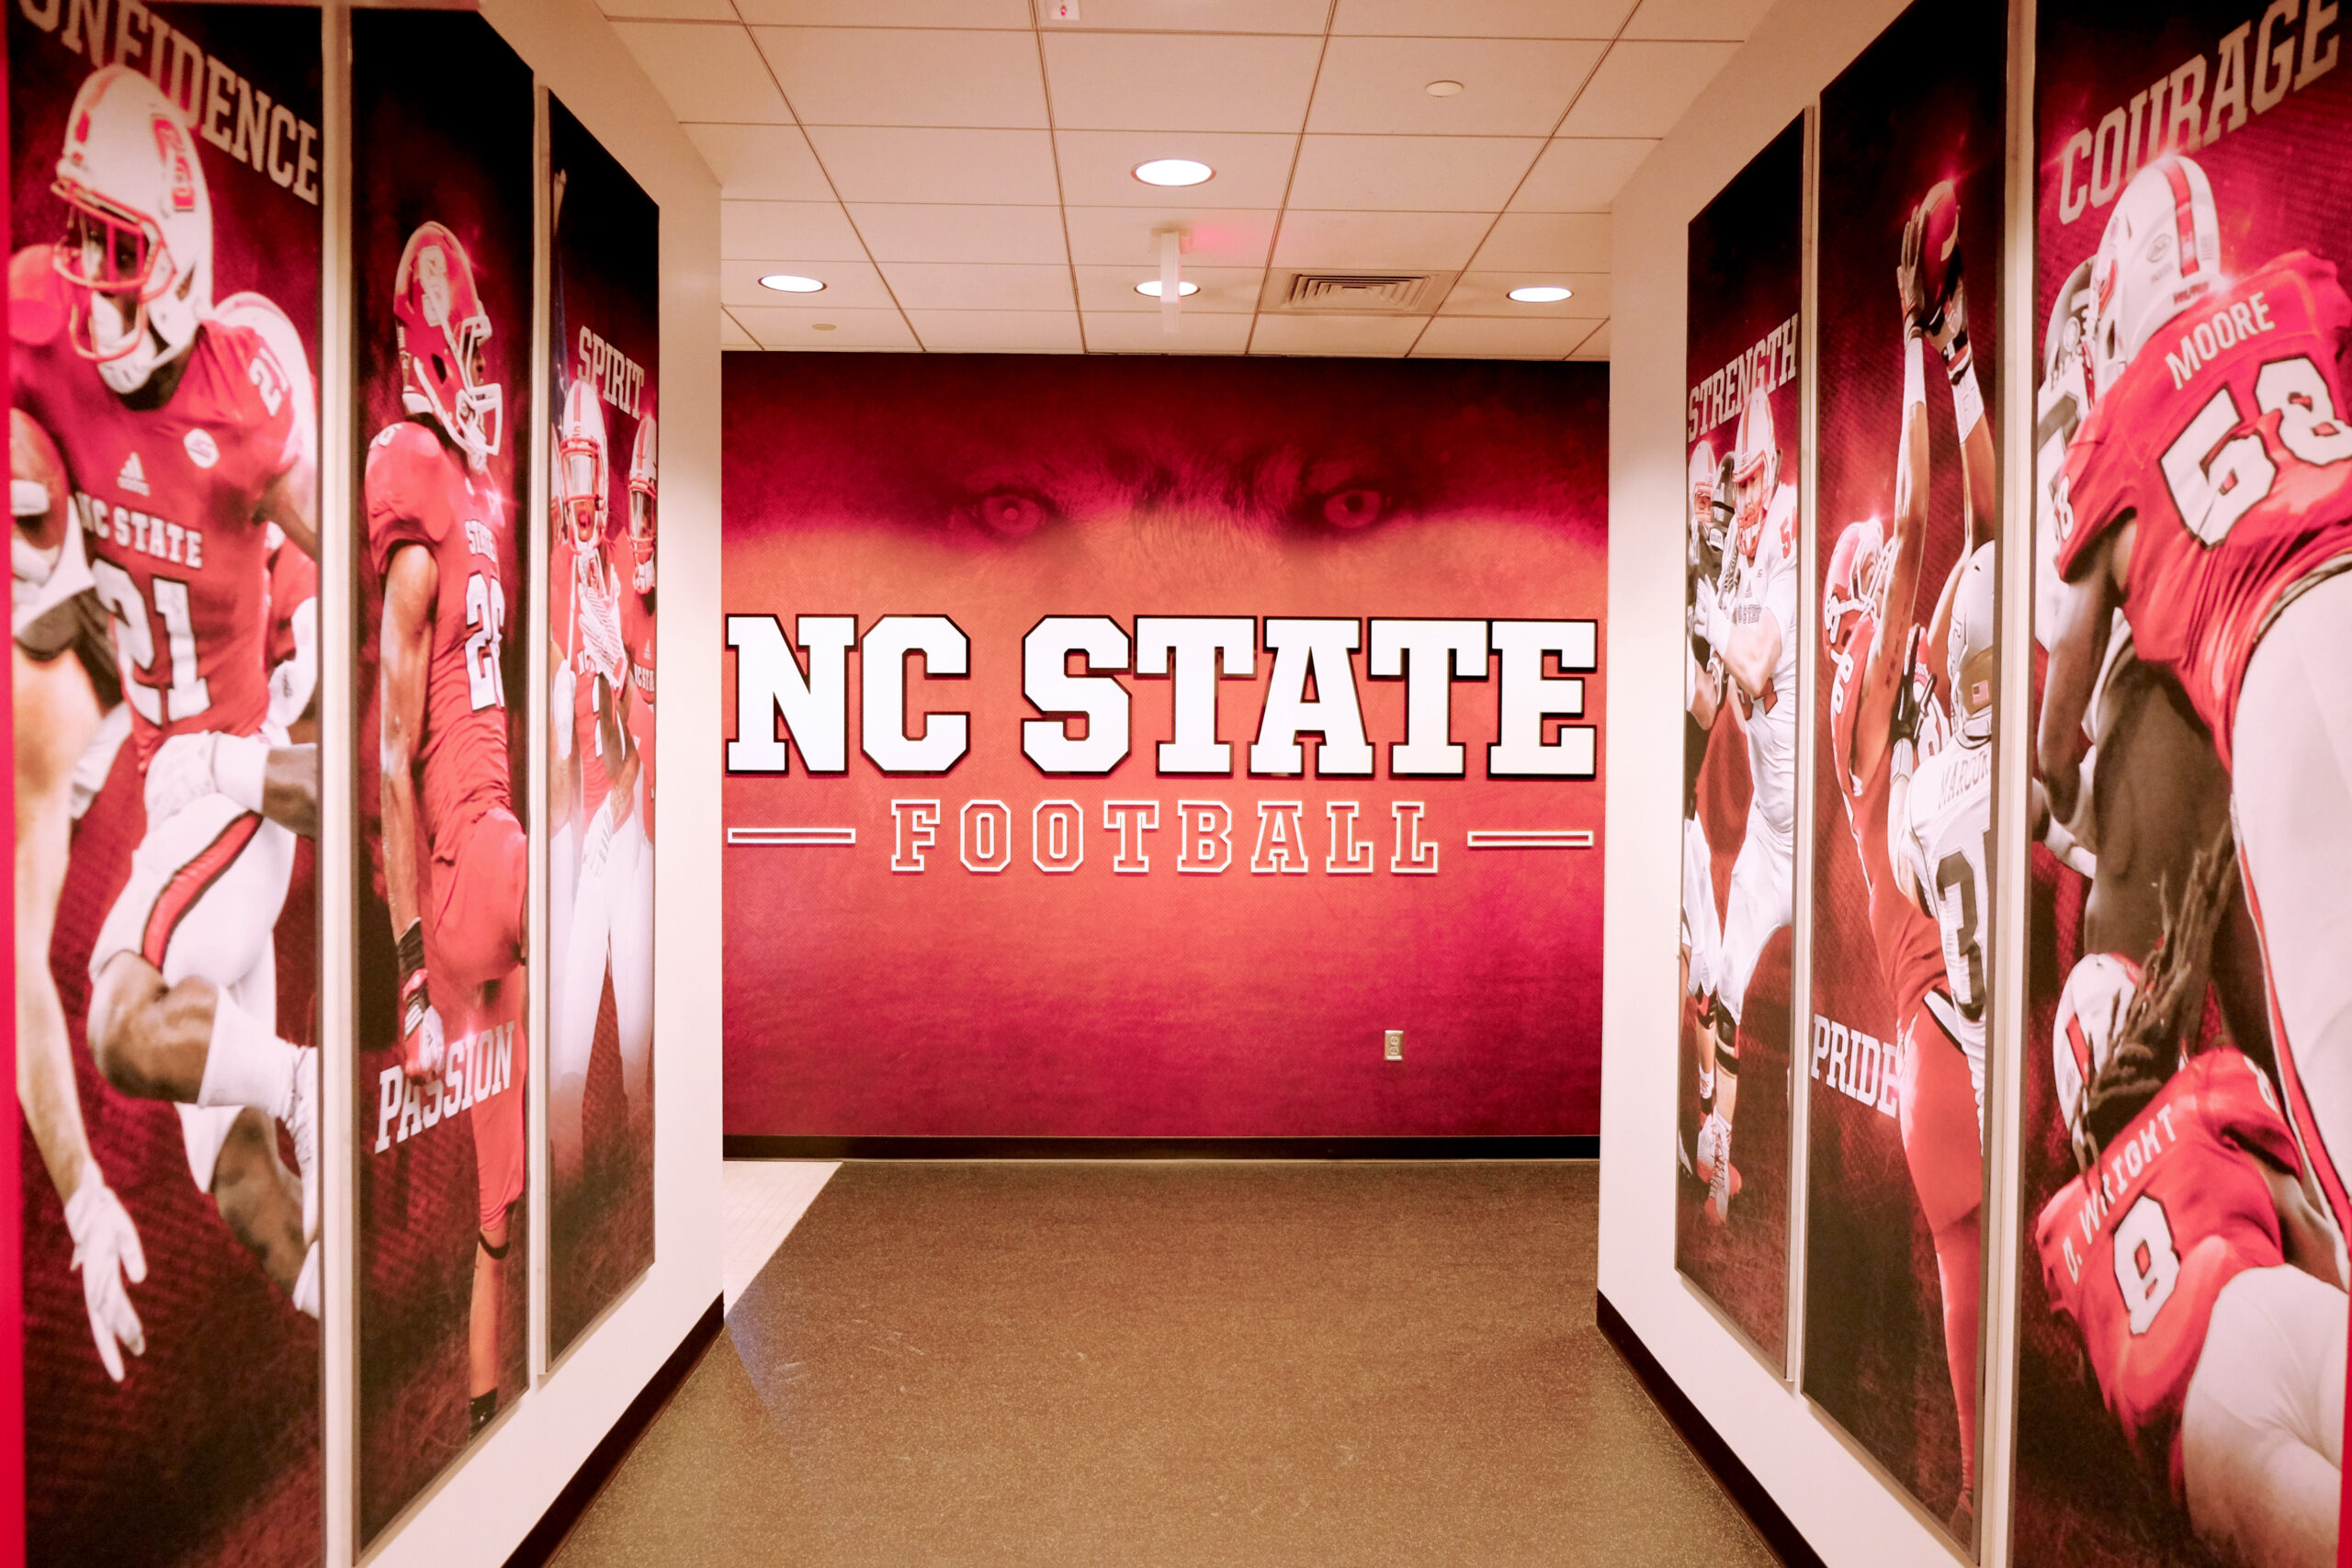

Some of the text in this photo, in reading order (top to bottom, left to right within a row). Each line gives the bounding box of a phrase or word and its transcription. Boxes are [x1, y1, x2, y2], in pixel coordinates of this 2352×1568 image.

[2059, 0, 2341, 225] COURAGE
[577, 325, 645, 421] SPIRIT
[1688, 313, 1799, 443] STRENGTH
[2165, 291, 2276, 390] MOORE
[113, 506, 202, 569] STATE
[94, 557, 211, 727] 21
[725, 614, 1599, 781] NC STATE
[891, 798, 1439, 875] FOOTBALL
[374, 1020, 516, 1155] PASSION
[1810, 1013, 1900, 1119] PRIDE
